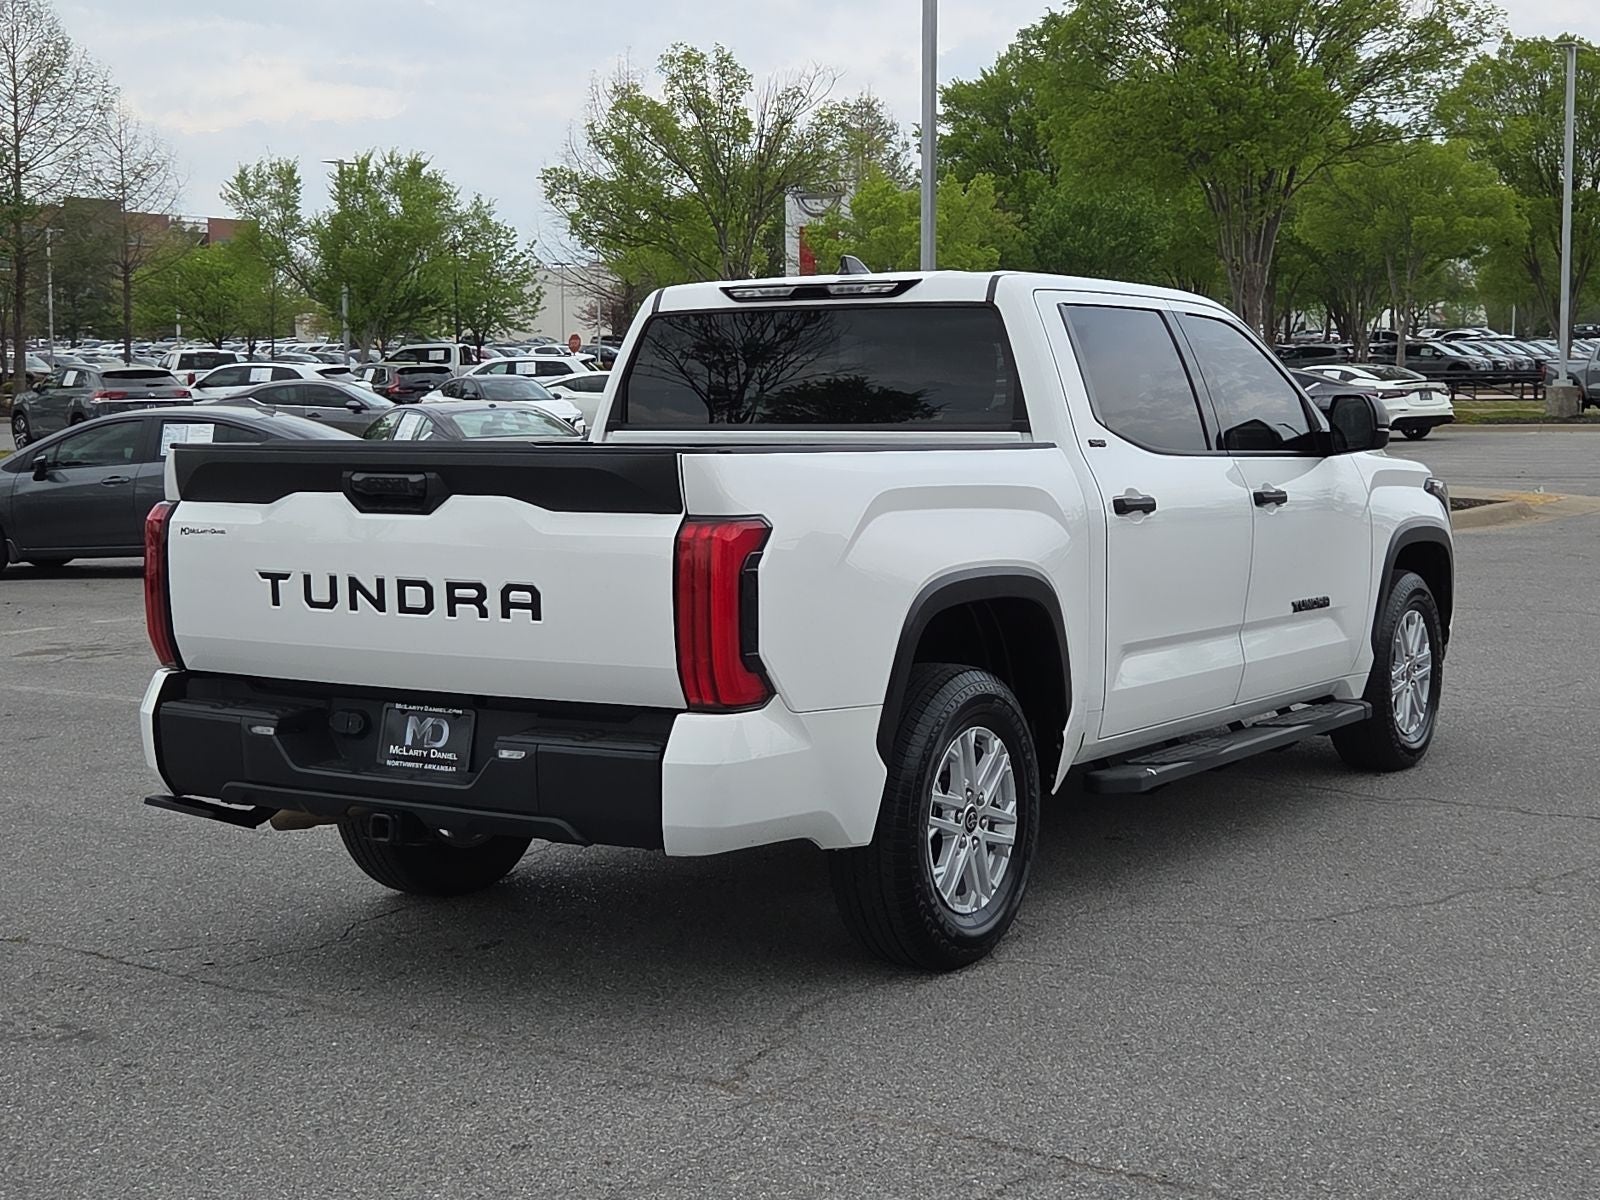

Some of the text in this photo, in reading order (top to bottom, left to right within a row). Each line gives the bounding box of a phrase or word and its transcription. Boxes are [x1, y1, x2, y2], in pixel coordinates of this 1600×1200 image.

[256, 569, 543, 623] TUNDRA
[386, 759, 456, 772] NORTHWEST ARKANSAS
